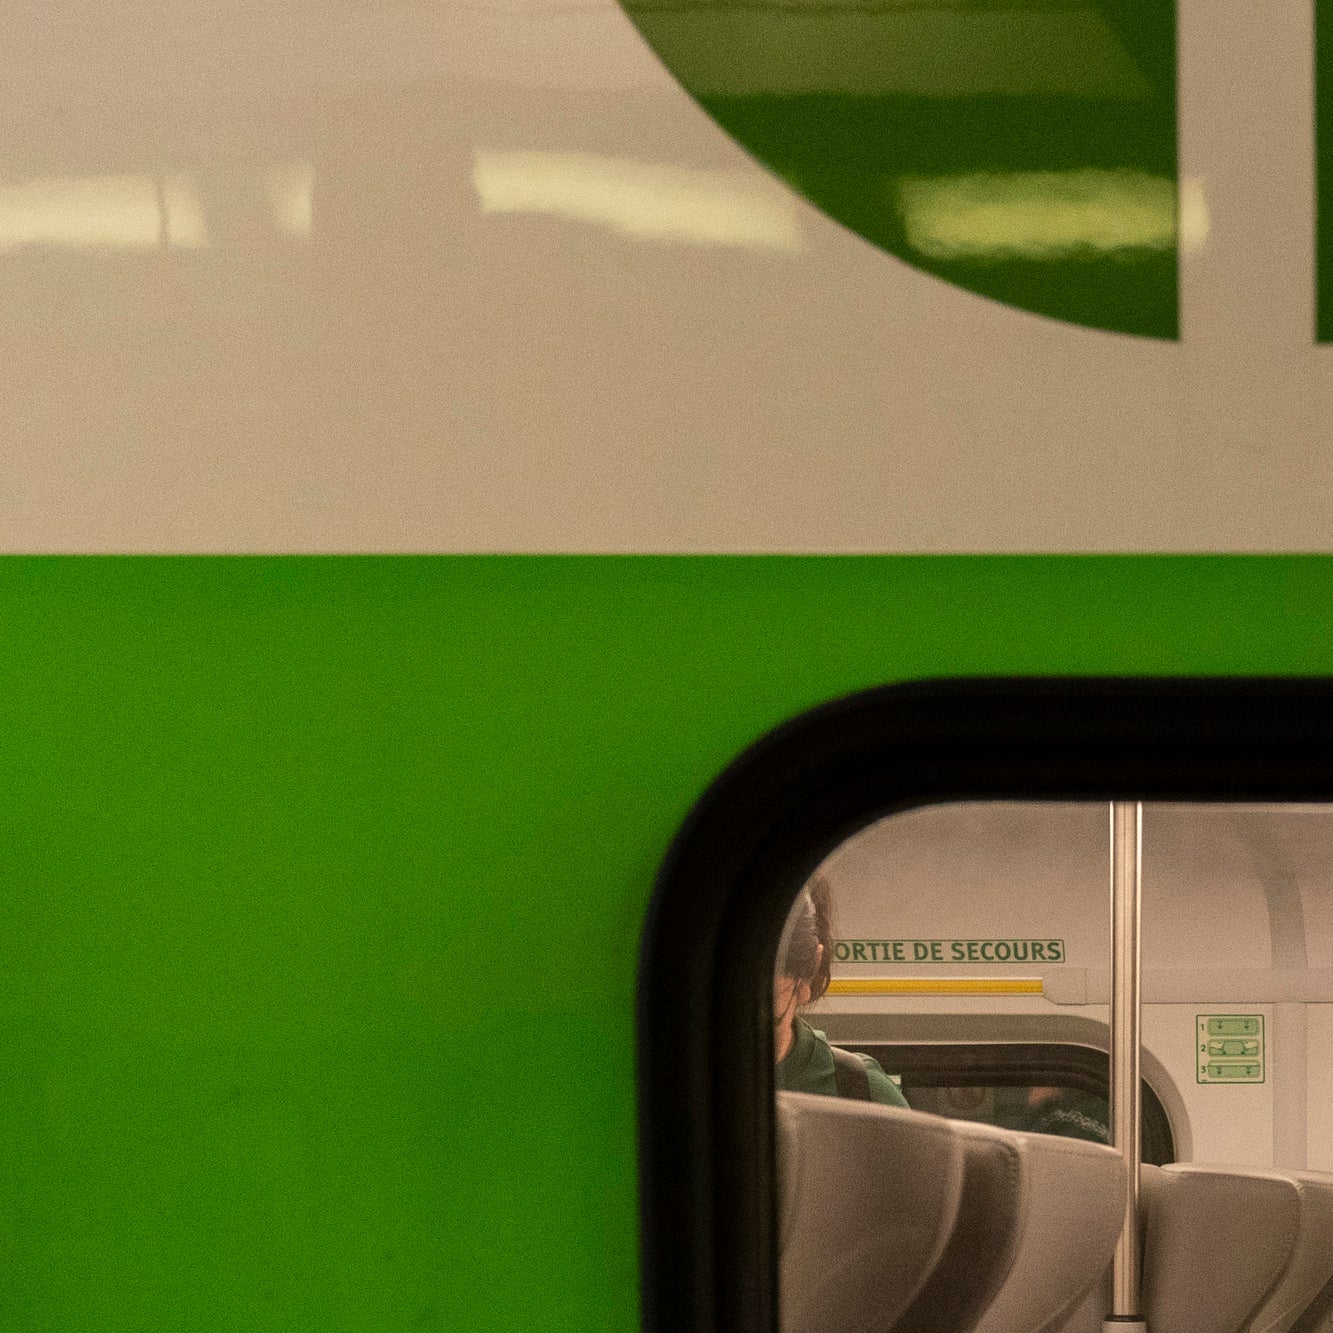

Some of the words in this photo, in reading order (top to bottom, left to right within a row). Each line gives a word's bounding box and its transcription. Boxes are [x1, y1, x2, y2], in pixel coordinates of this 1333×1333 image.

[834, 942, 905, 961] ORTIE
[914, 942, 944, 961] DE
[951, 942, 1062, 961] SECOURS
[1200, 1023, 1205, 1031] 1
[1200, 1044, 1206, 1053] 2
[1201, 1065, 1206, 1074] 3
